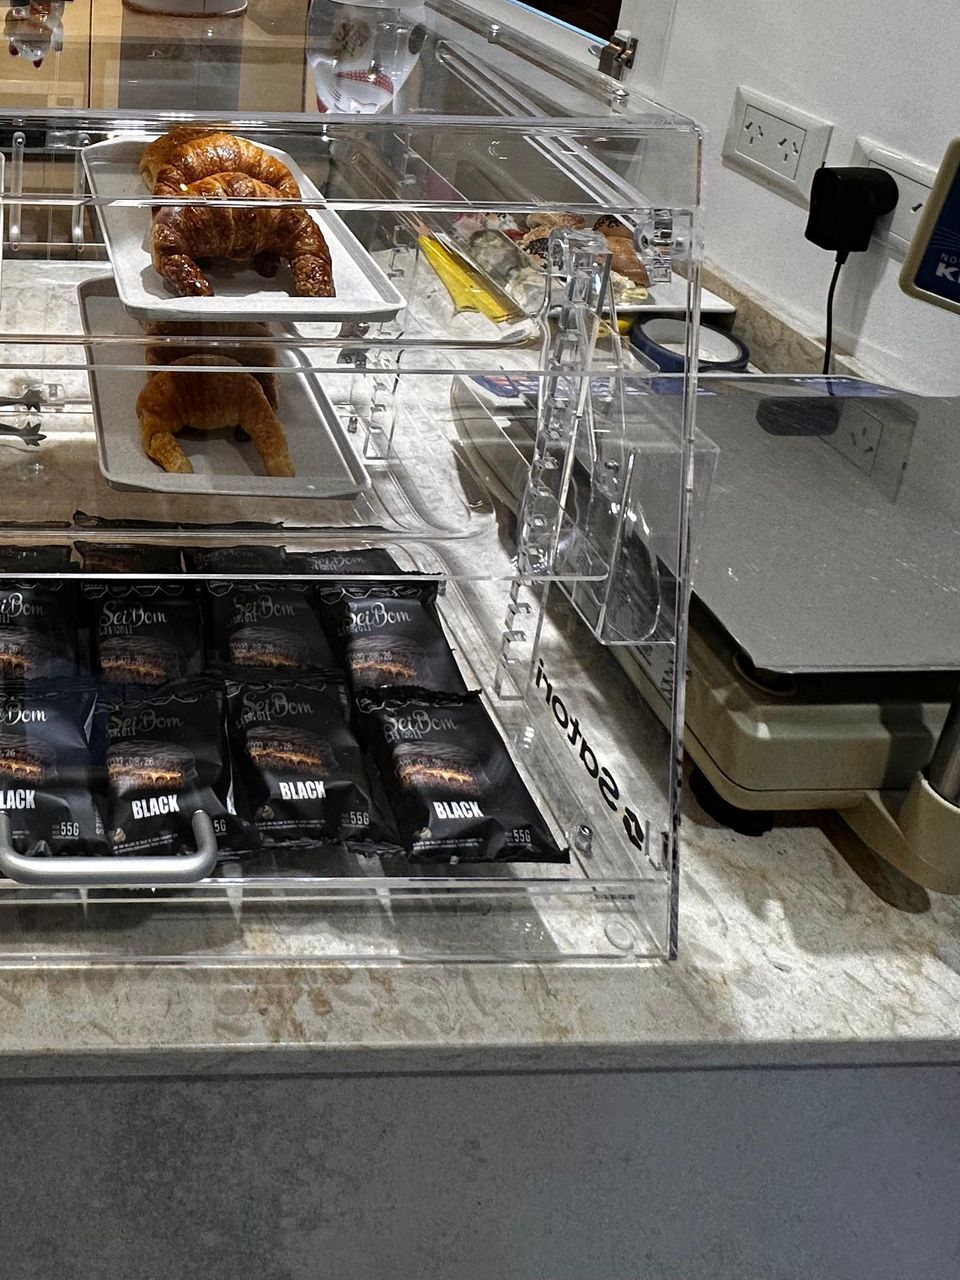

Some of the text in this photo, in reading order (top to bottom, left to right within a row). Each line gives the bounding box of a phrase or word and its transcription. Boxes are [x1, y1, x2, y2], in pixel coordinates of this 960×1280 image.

[279, 780, 327, 800] BLACK
[131, 793, 181, 820] BLACK
[432, 800, 484, 820] BLACK
[214, 819, 228, 833] 5G
[350, 811, 370, 826] 55G
[60, 822, 80, 836] 55G
[513, 829, 531, 843] 55G
